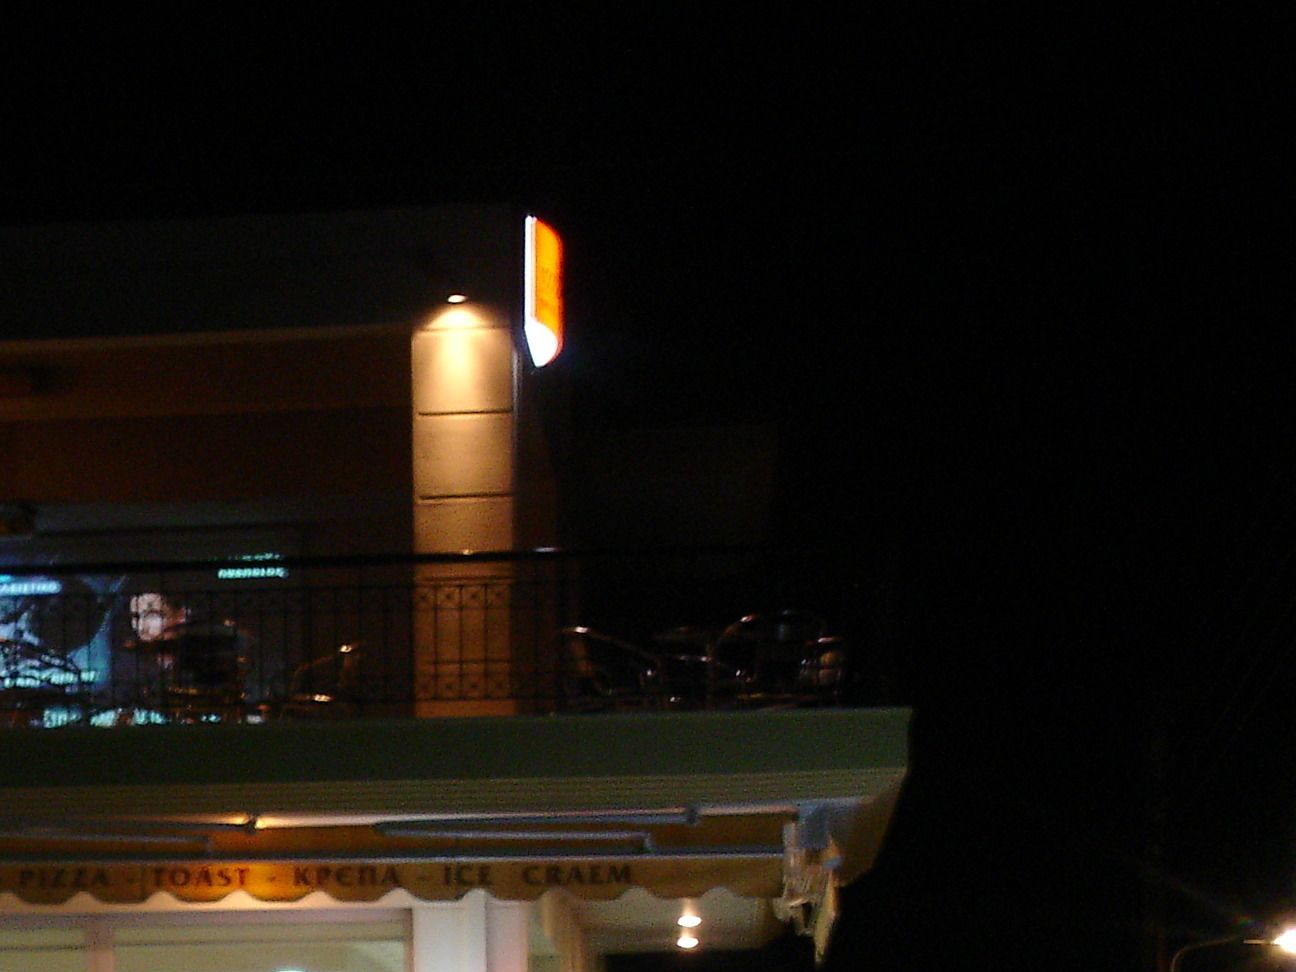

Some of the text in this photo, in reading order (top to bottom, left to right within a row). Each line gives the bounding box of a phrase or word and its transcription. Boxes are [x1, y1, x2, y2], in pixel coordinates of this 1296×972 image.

[19, 867, 108, 887] PIZZA
[153, 866, 250, 887] TOAST
[442, 865, 493, 885] ICE
[522, 863, 633, 885] CRAEM
